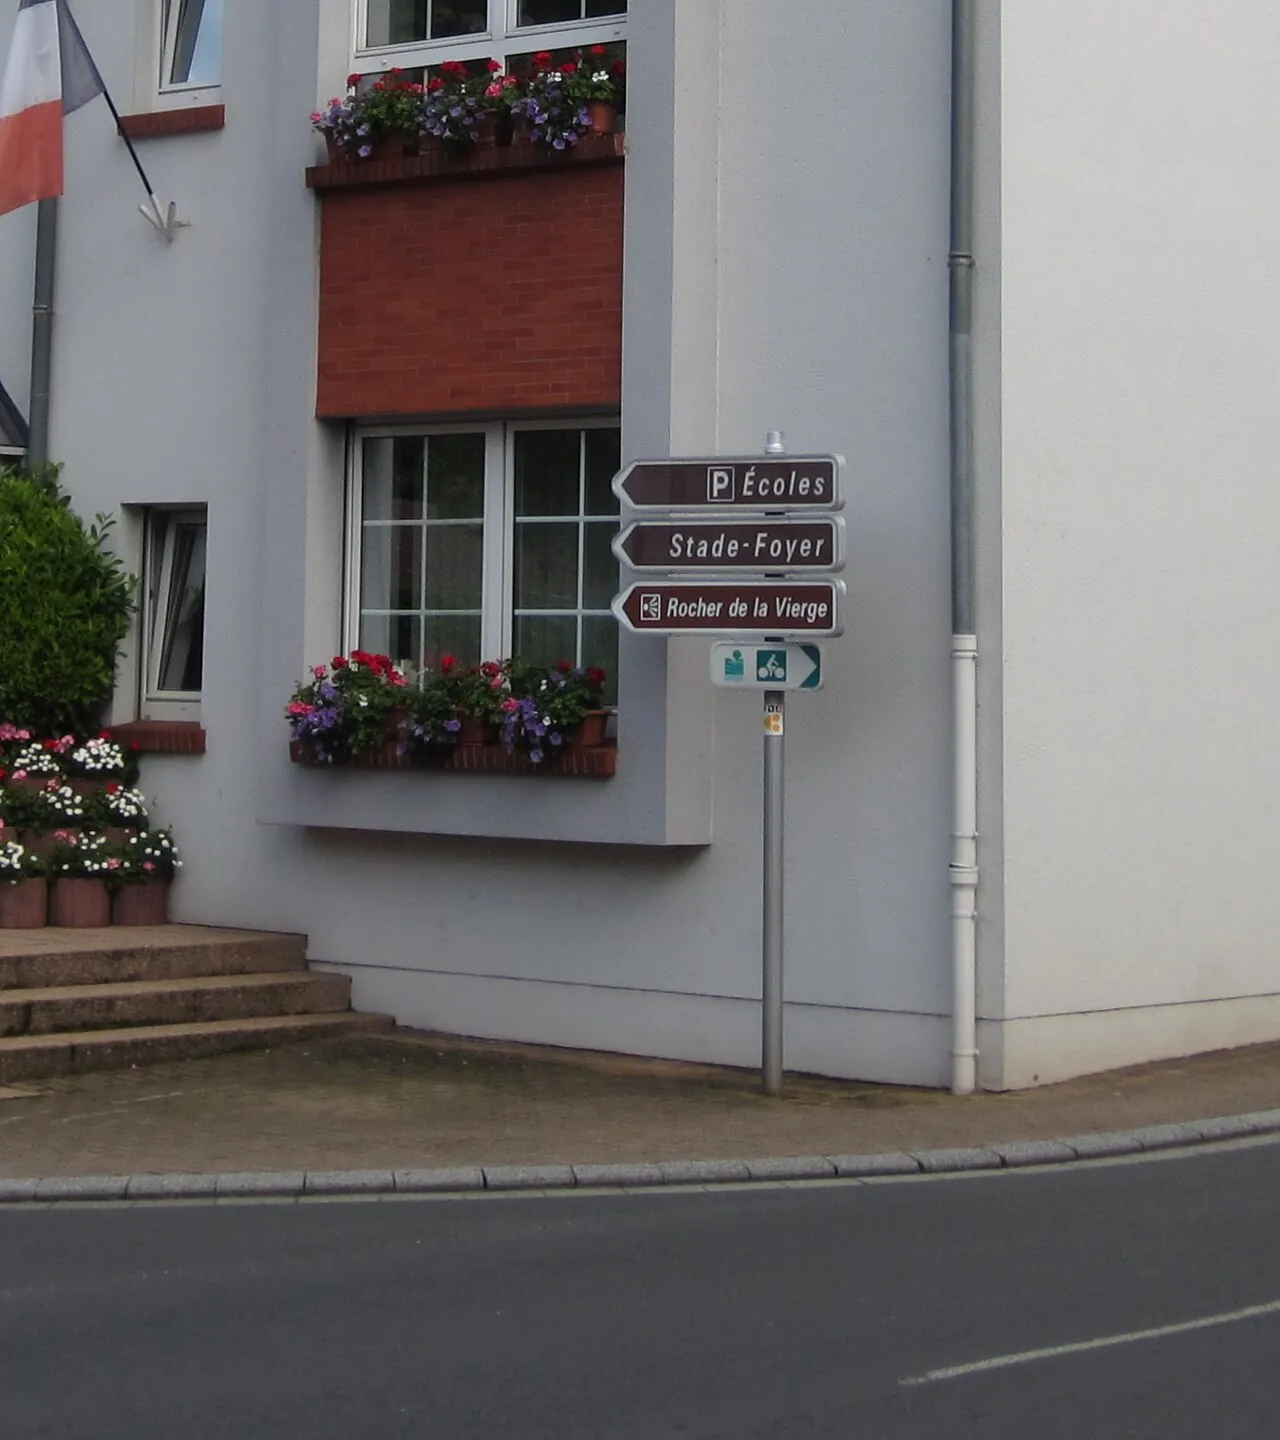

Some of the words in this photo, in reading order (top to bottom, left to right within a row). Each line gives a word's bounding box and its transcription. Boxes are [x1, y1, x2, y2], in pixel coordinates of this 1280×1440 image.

[712, 471, 729, 497] P
[742, 466, 825, 496] Écoles
[670, 533, 825, 562] Stade-Foyer
[667, 597, 723, 617] Rocher
[729, 597, 747, 617] de
[753, 597, 768, 617] la
[776, 597, 828, 623] Vierge
